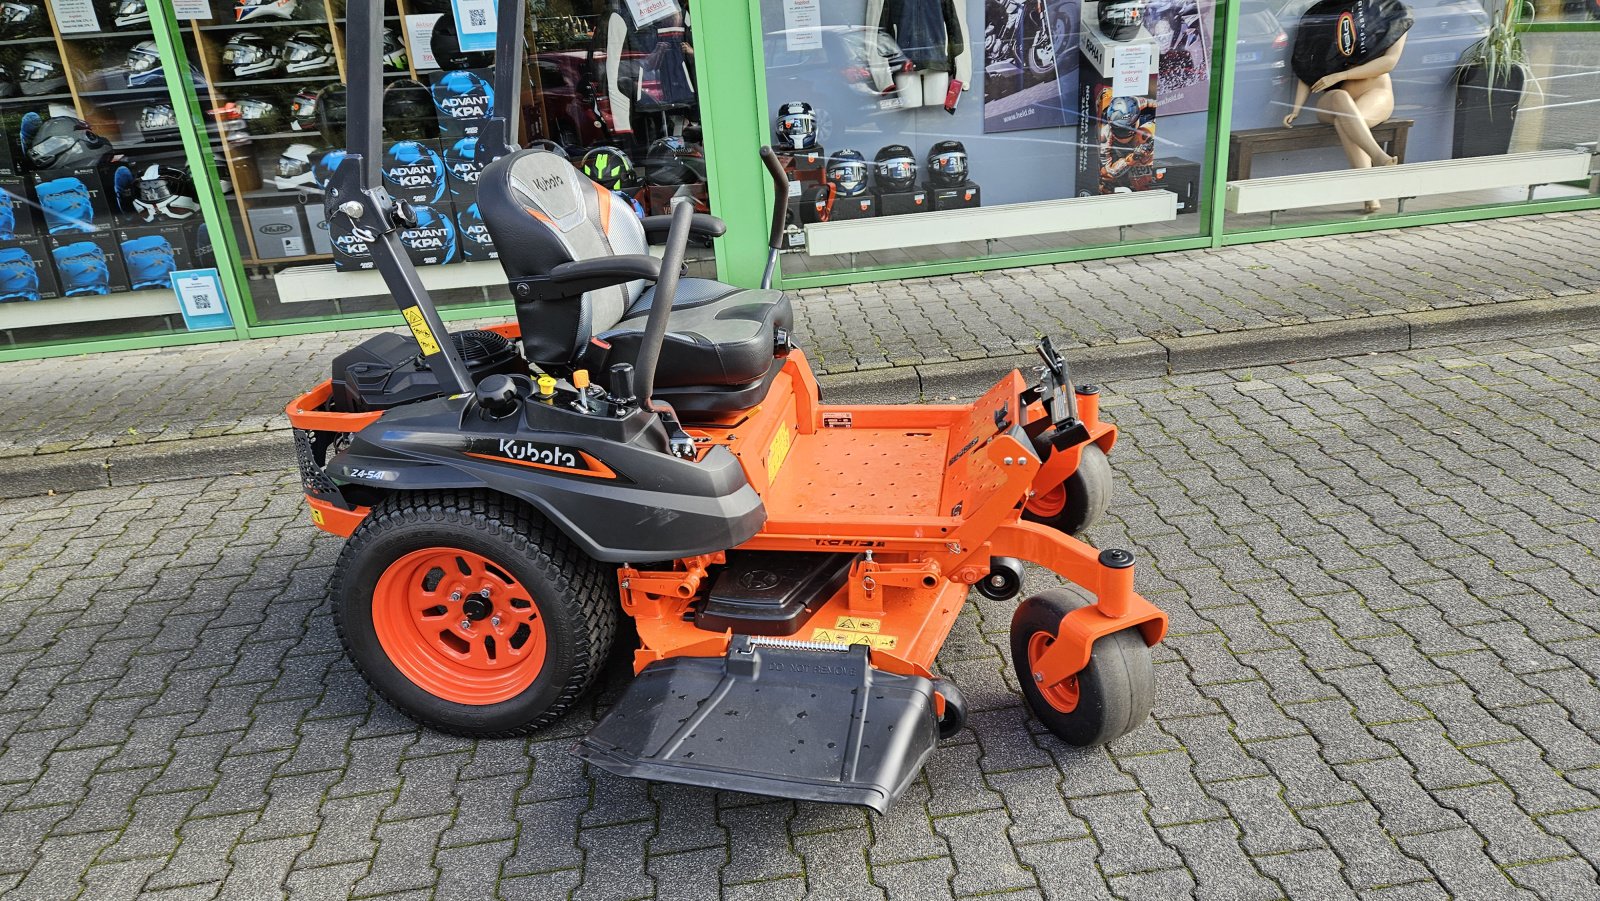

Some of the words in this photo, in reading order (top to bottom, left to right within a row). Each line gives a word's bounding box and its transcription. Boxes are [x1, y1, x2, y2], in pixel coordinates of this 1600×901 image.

[441, 95, 490, 108] ADVANT
[451, 106, 484, 117] KPA
[1003, 108, 1035, 122] www.held.de
[389, 165, 438, 177] ADVANT
[400, 175, 432, 186] KPA
[532, 174, 564, 191] Kubota
[401, 229, 449, 240] ADVANT
[410, 239, 442, 250] KPA
[499, 438, 576, 468] Kubota
[768, 662, 785, 671] DO
[790, 663, 811, 674] NOT
[813, 665, 857, 677] REMOVE
